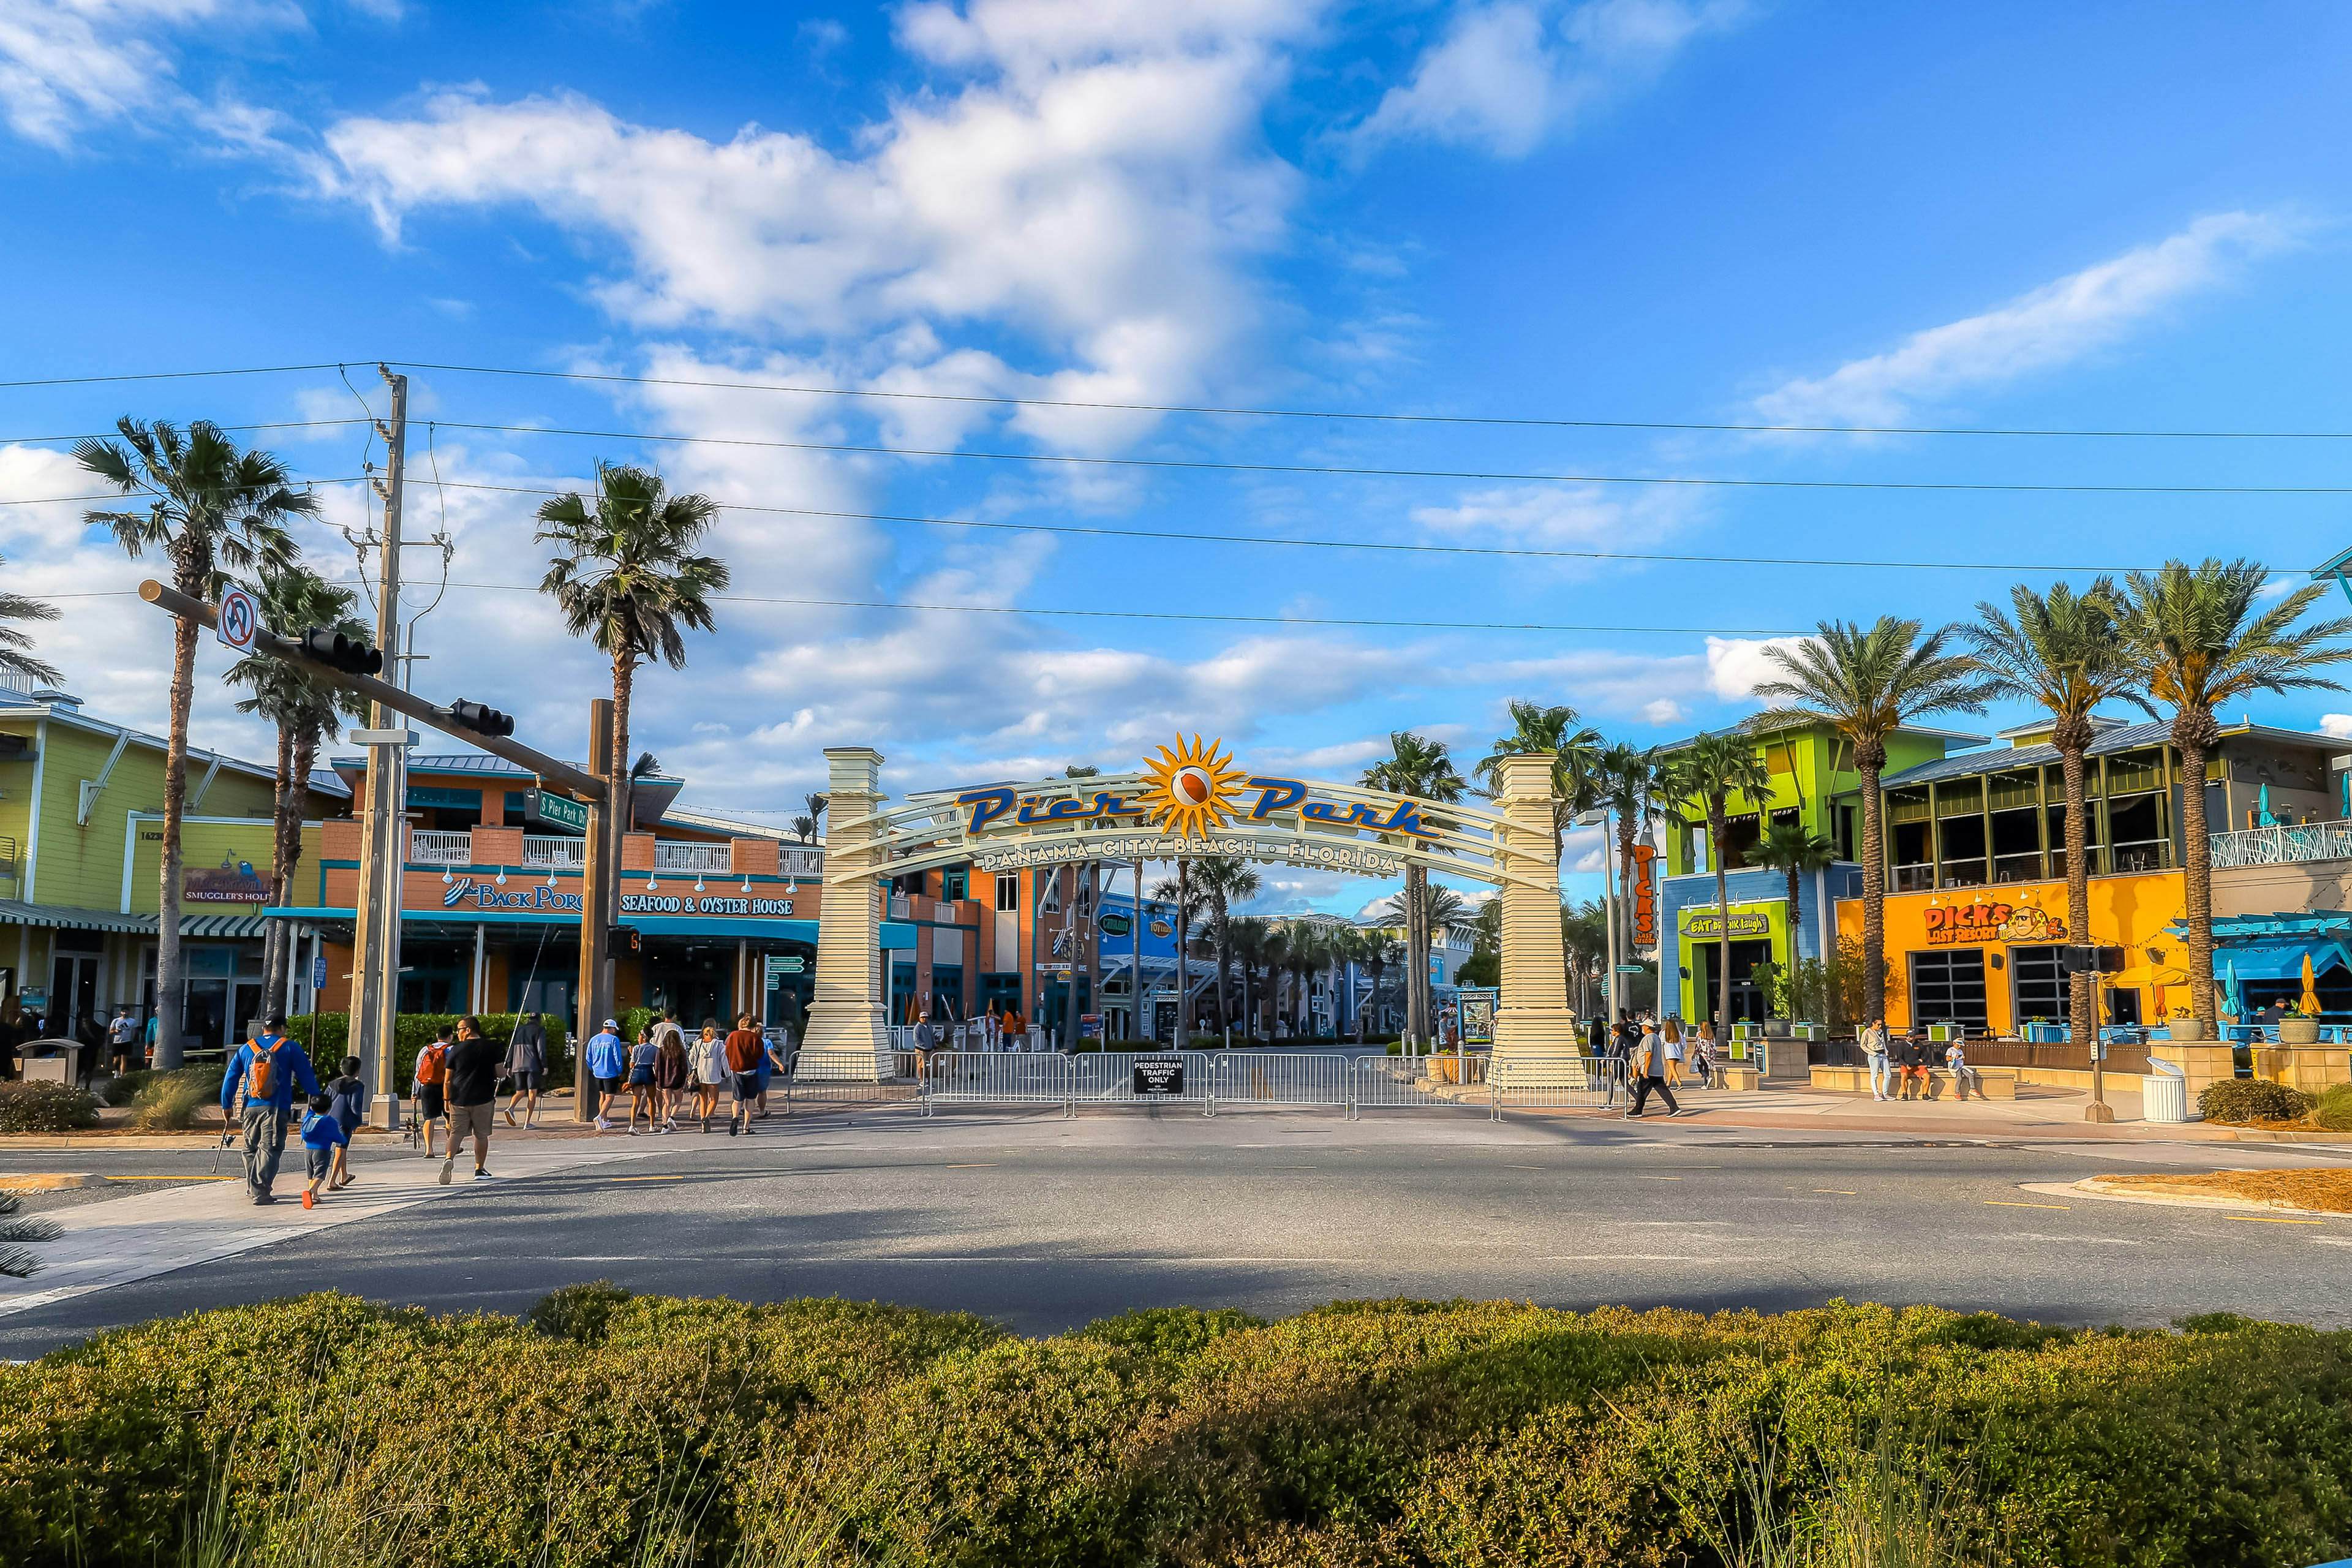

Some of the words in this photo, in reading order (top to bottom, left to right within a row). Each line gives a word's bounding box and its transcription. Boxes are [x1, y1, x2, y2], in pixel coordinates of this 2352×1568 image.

[541, 796, 546, 812] S
[548, 799, 561, 816] Pier
[563, 804, 576, 822] Park
[578, 809, 586, 824] Dr
[954, 786, 1146, 837] Pier
[1241, 775, 1444, 840] Park
[984, 842, 1088, 870] PANAMA
[1101, 838, 1161, 856] CITY
[1173, 837, 1256, 856] BEACH
[1288, 843, 1397, 872] FLORIDA
[186, 891, 243, 900] SMUGGLER'S
[478, 884, 532, 908] BACK
[533, 886, 584, 913] PORC
[1634, 845, 1654, 932] DICK'S
[621, 895, 680, 913] SEAFOOD
[684, 897, 696, 913] &
[699, 897, 749, 914] OYSTER
[751, 899, 793, 915] HOUSE
[1924, 903, 2013, 930] DICK'S
[1691, 919, 1713, 933] EAT
[1740, 915, 1763, 933] laugh
[1926, 929, 1955, 944] LAST
[1956, 927, 1999, 943] RESORT
